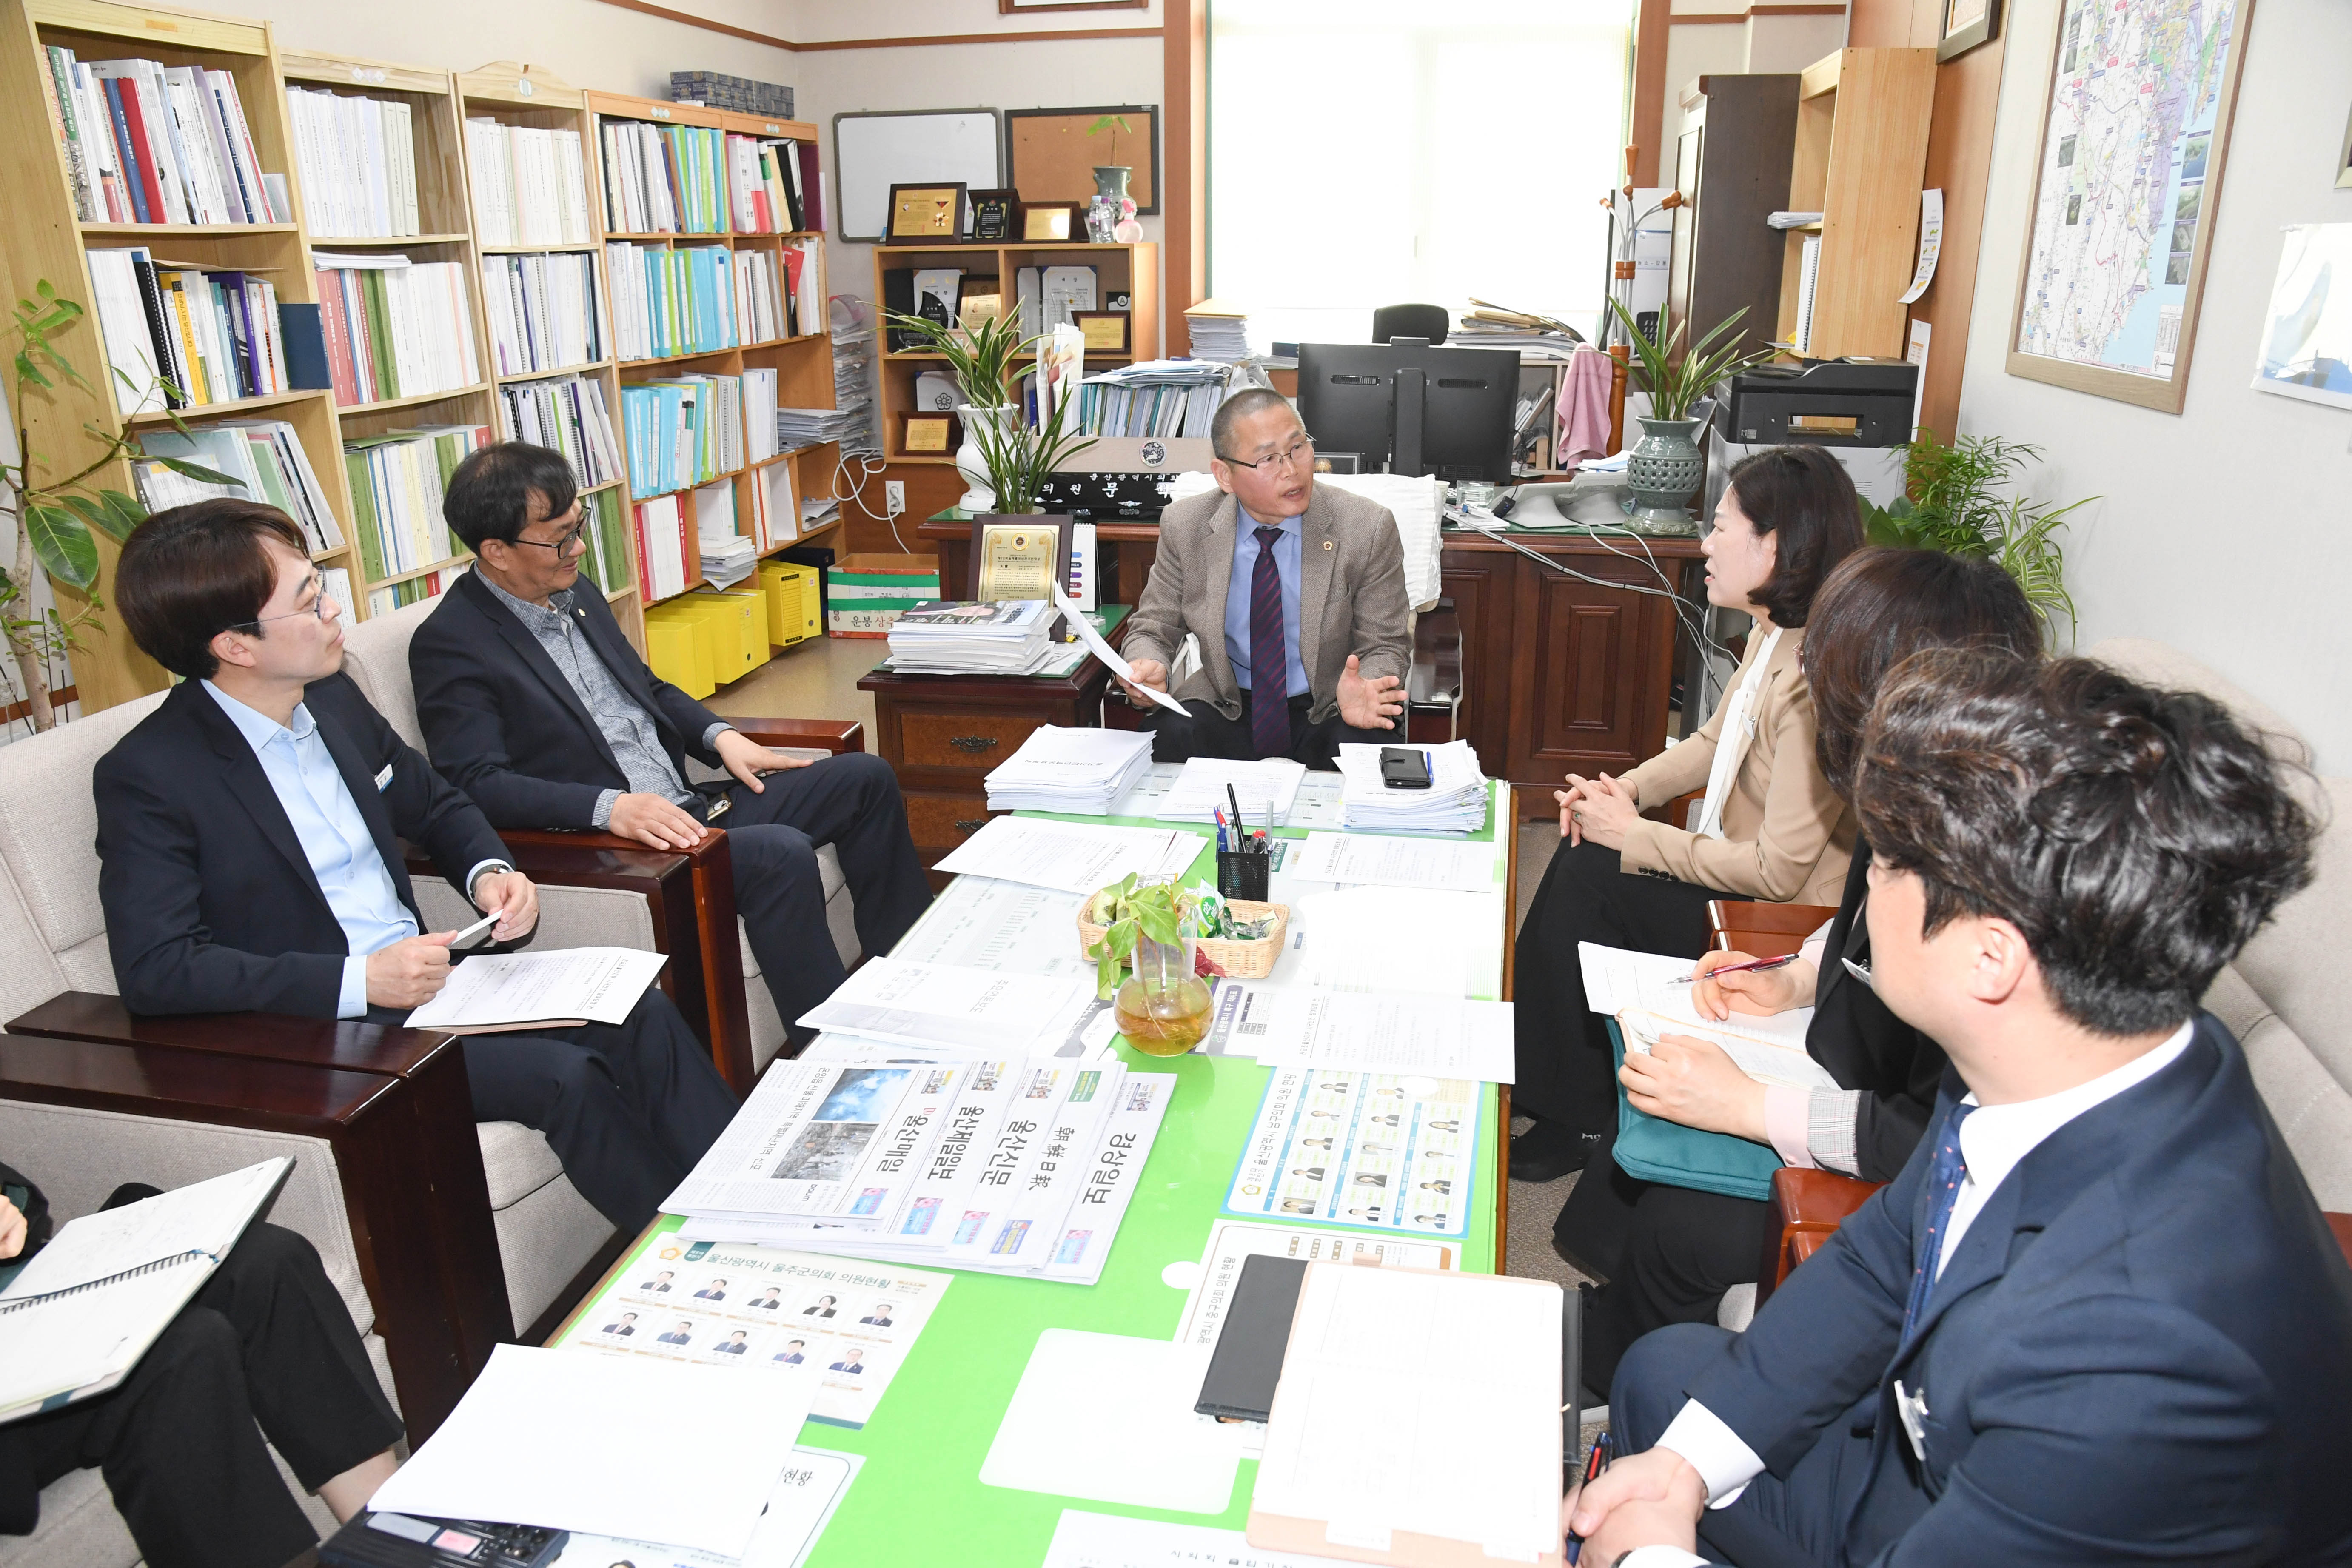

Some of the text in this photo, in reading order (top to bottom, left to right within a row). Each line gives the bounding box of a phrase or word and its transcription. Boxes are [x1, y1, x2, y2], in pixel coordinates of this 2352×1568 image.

[851, 616, 872, 627] 운봉
[1254, 1073, 1297, 1167] 울산광역시 남구의회 의원 현황
[876, 1114, 929, 1172] 울산매일
[927, 1106, 985, 1181] 울산제일일보
[979, 1120, 1037, 1187] 울산신문
[1028, 1126, 1075, 1192] 朝鮮日報
[749, 1158, 766, 1170] 선포
[1082, 1132, 1137, 1205] 경상일보
[707, 1253, 892, 1289] 울산광역시 울주군의회 의원현황
[1215, 1273, 1231, 1287] 의원
[1221, 1257, 1236, 1271] 현황
[1206, 1289, 1225, 1319] 중구의회
[780, 1466, 813, 1486] 현황
